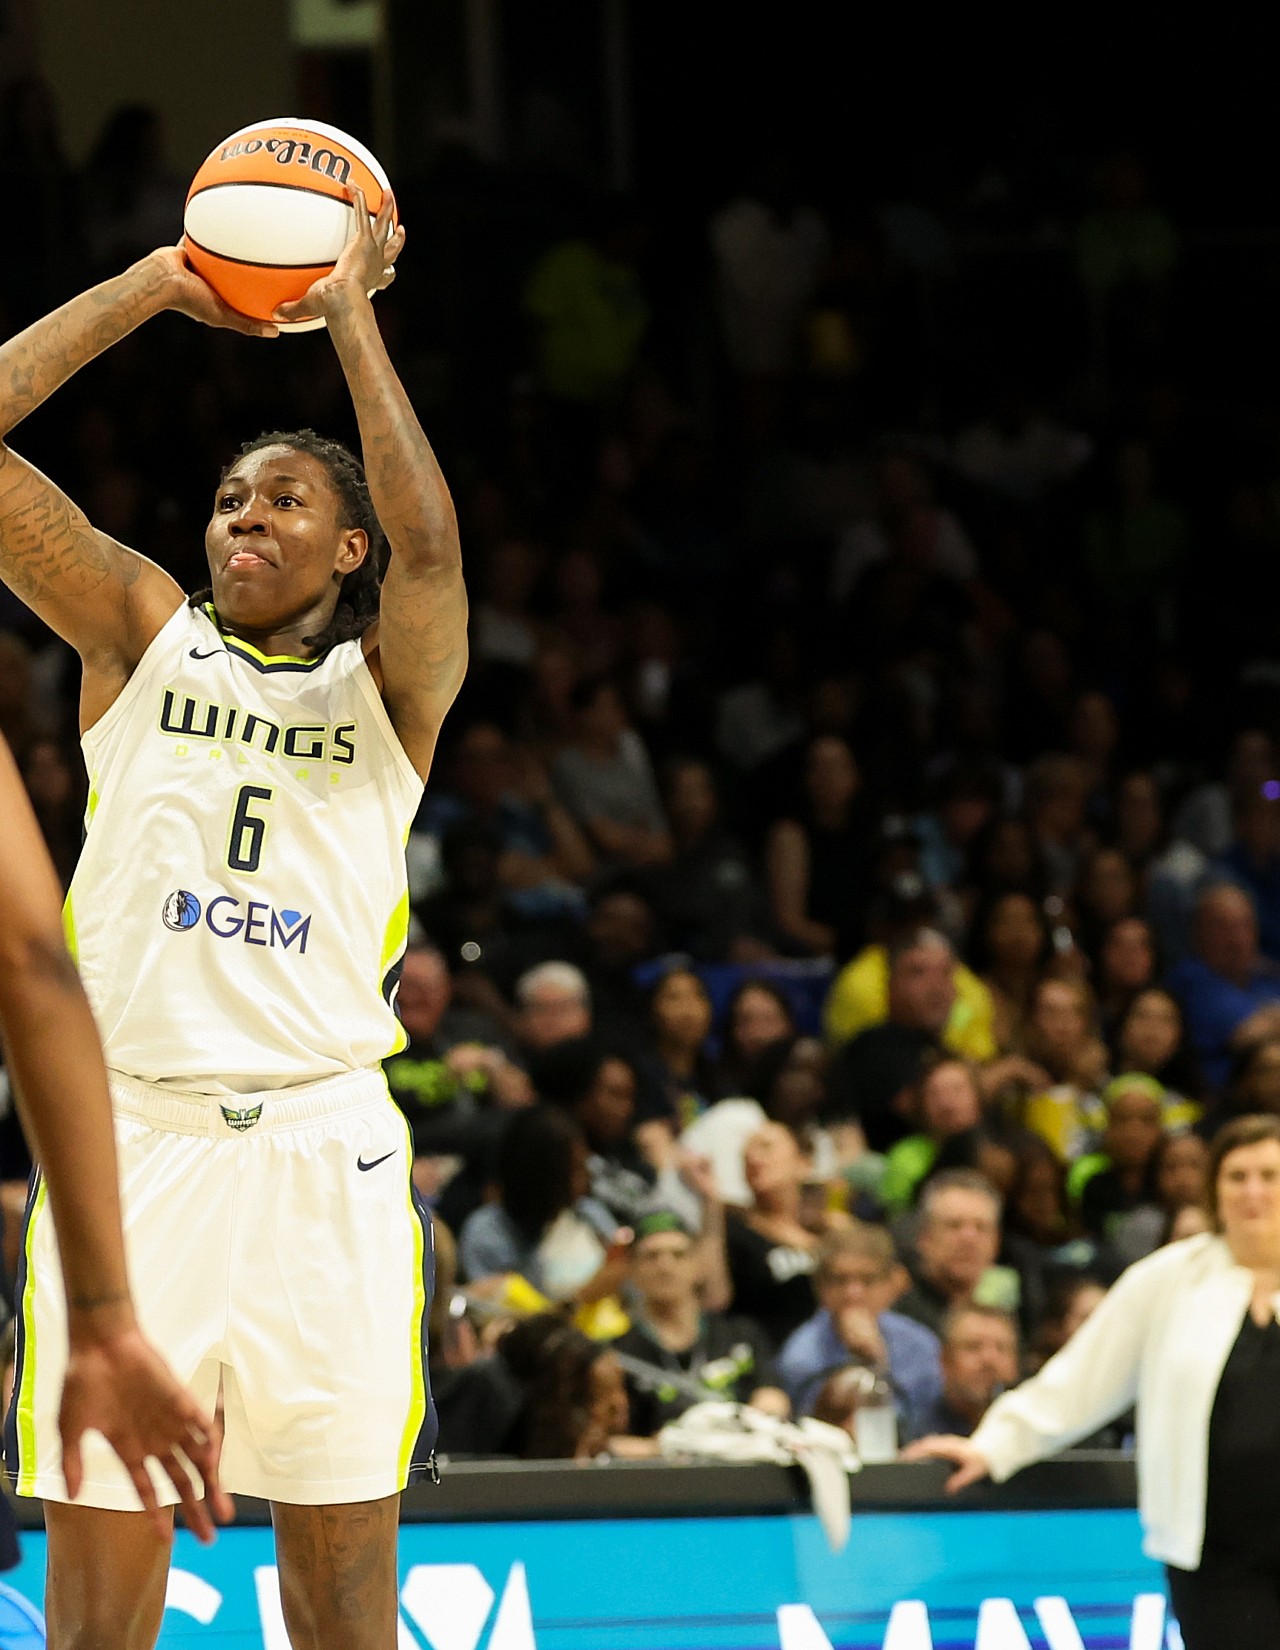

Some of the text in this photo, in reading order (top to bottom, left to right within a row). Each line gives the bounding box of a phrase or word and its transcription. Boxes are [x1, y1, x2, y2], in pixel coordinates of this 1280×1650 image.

[220, 138, 352, 186] Wilson
[158, 687, 358, 766] WINGS
[226, 783, 274, 874] 6
[205, 895, 312, 954] GEM
